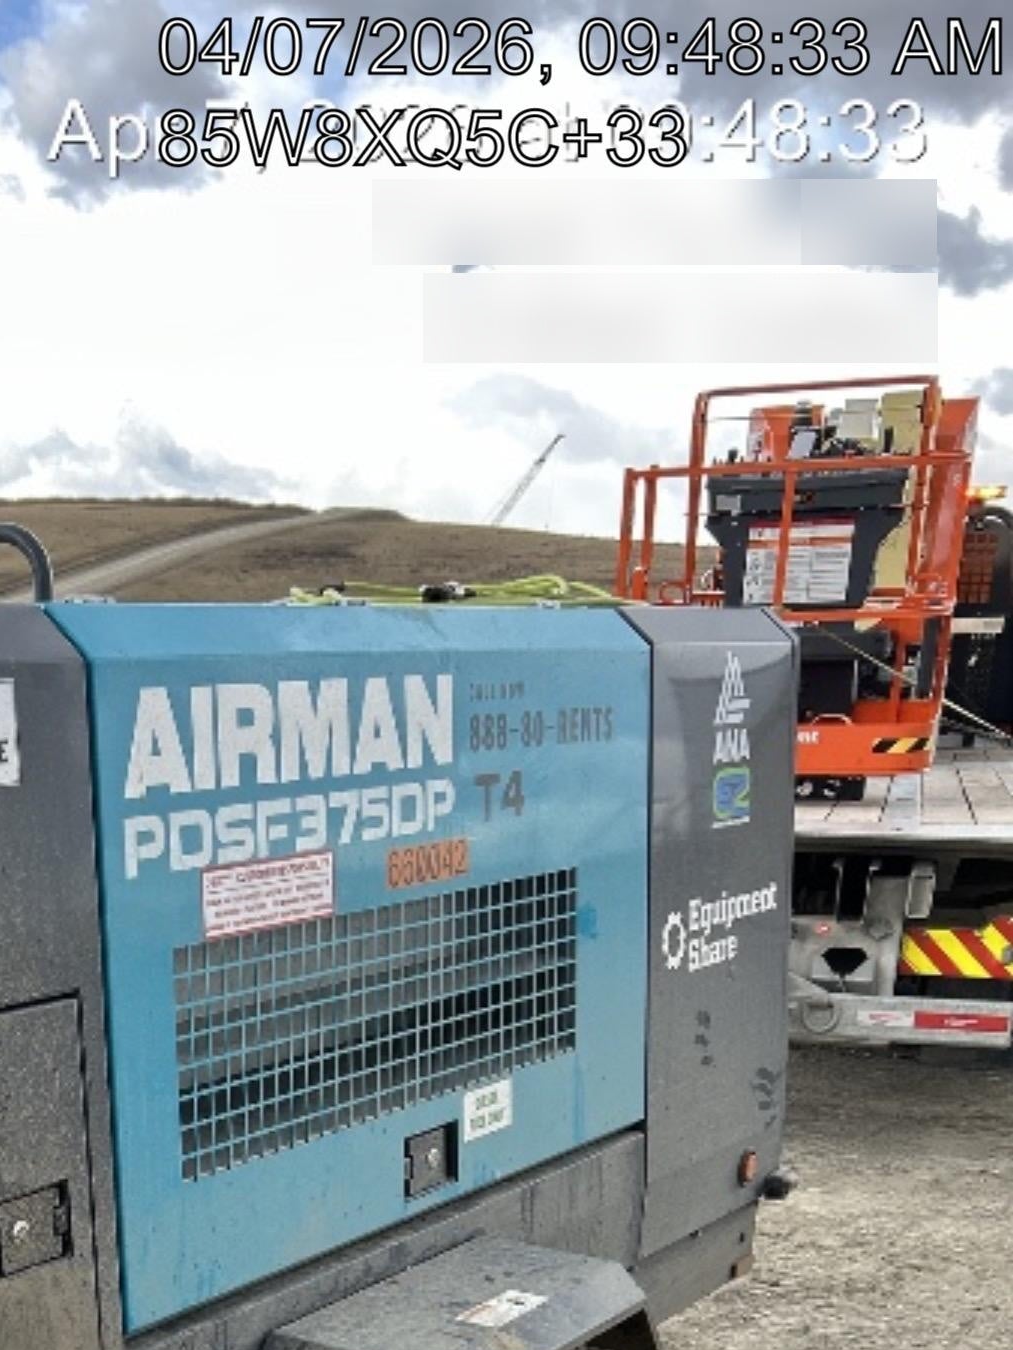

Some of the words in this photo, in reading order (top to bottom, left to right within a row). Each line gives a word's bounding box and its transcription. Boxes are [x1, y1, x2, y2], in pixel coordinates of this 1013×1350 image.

[124, 674, 454, 800] AIRMAN
[713, 728, 750, 766] ANA
[475, 769, 525, 823] T4
[124, 779, 456, 880] PDSF375DP
[689, 881, 777, 936] Equipment
[689, 936, 739, 973] Share
